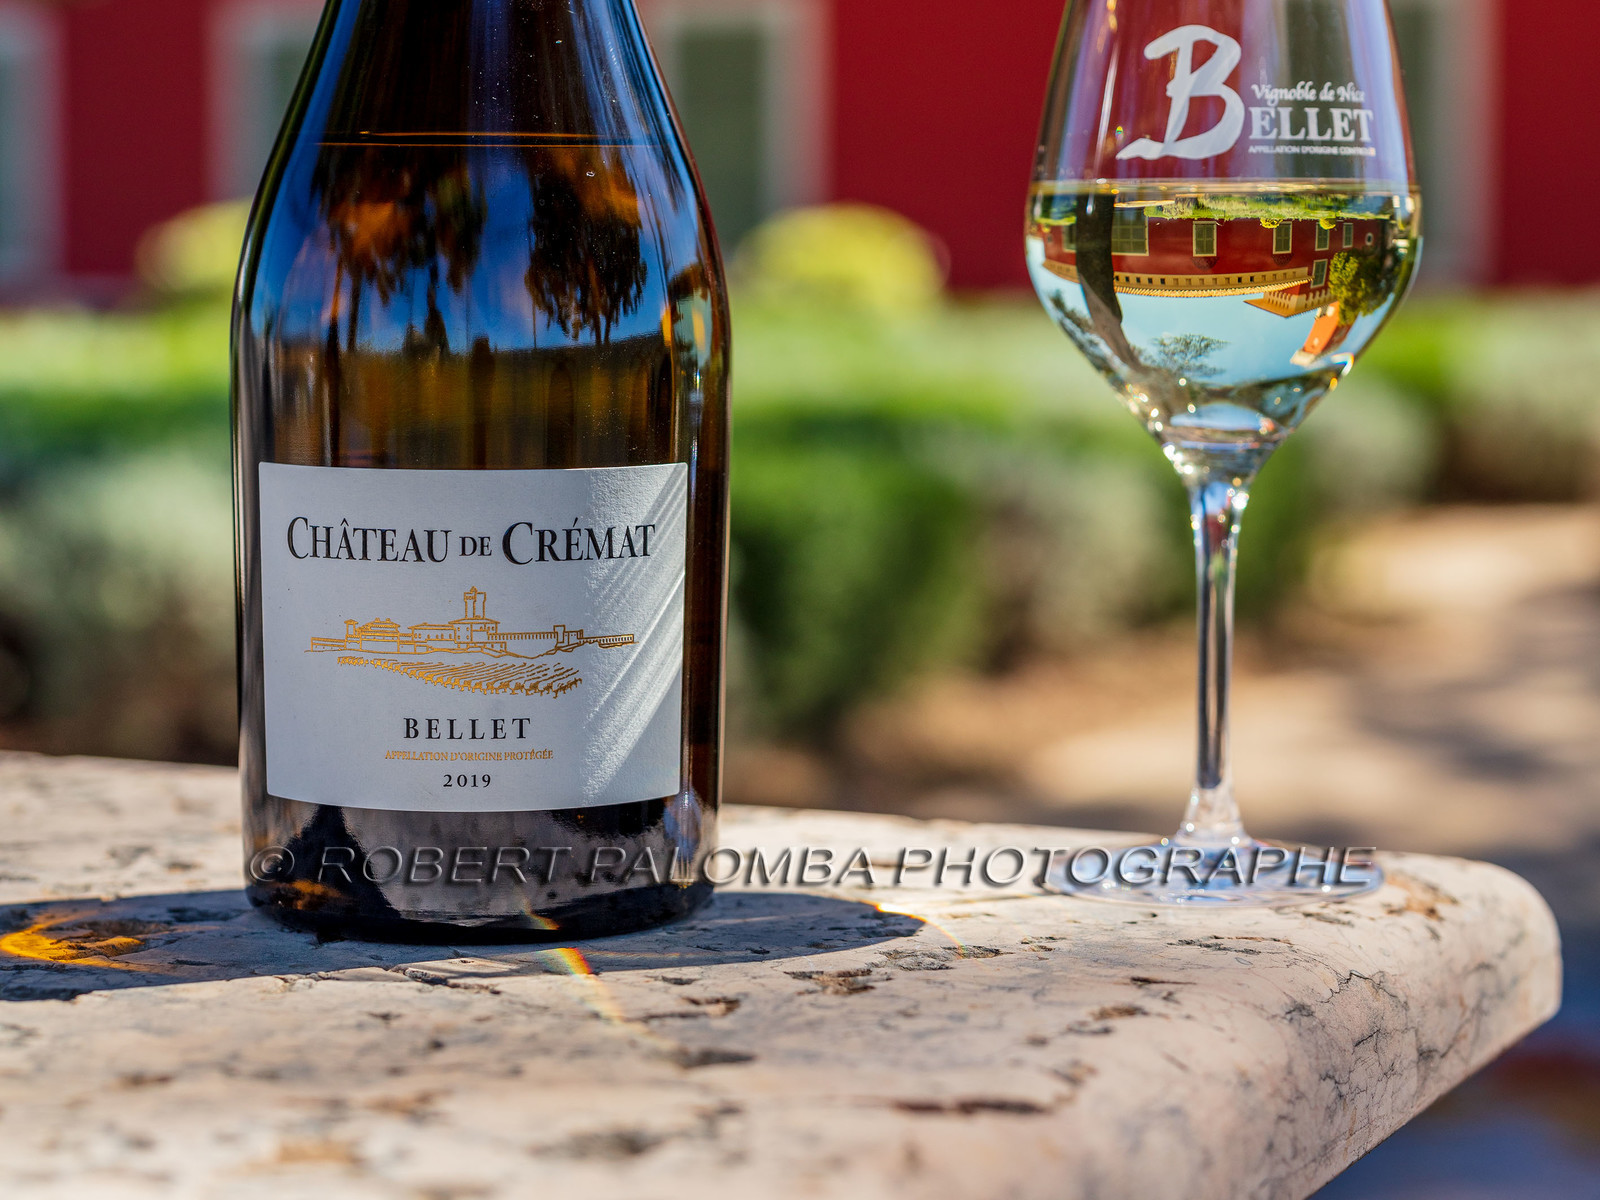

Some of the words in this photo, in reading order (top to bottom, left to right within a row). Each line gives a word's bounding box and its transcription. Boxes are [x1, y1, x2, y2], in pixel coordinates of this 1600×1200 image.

[1251, 81, 1317, 106] Vignoble
[1319, 81, 1335, 102] de
[287, 516, 452, 563] CHÂTEAU
[459, 535, 492, 558] DE
[501, 517, 656, 565] CRÉMAT
[403, 717, 532, 740] BELLET
[385, 750, 448, 761] APPELLATION
[450, 751, 502, 761] D'ORIGINE
[504, 749, 554, 760] PROTÉGÉE
[443, 774, 491, 788] 2019
